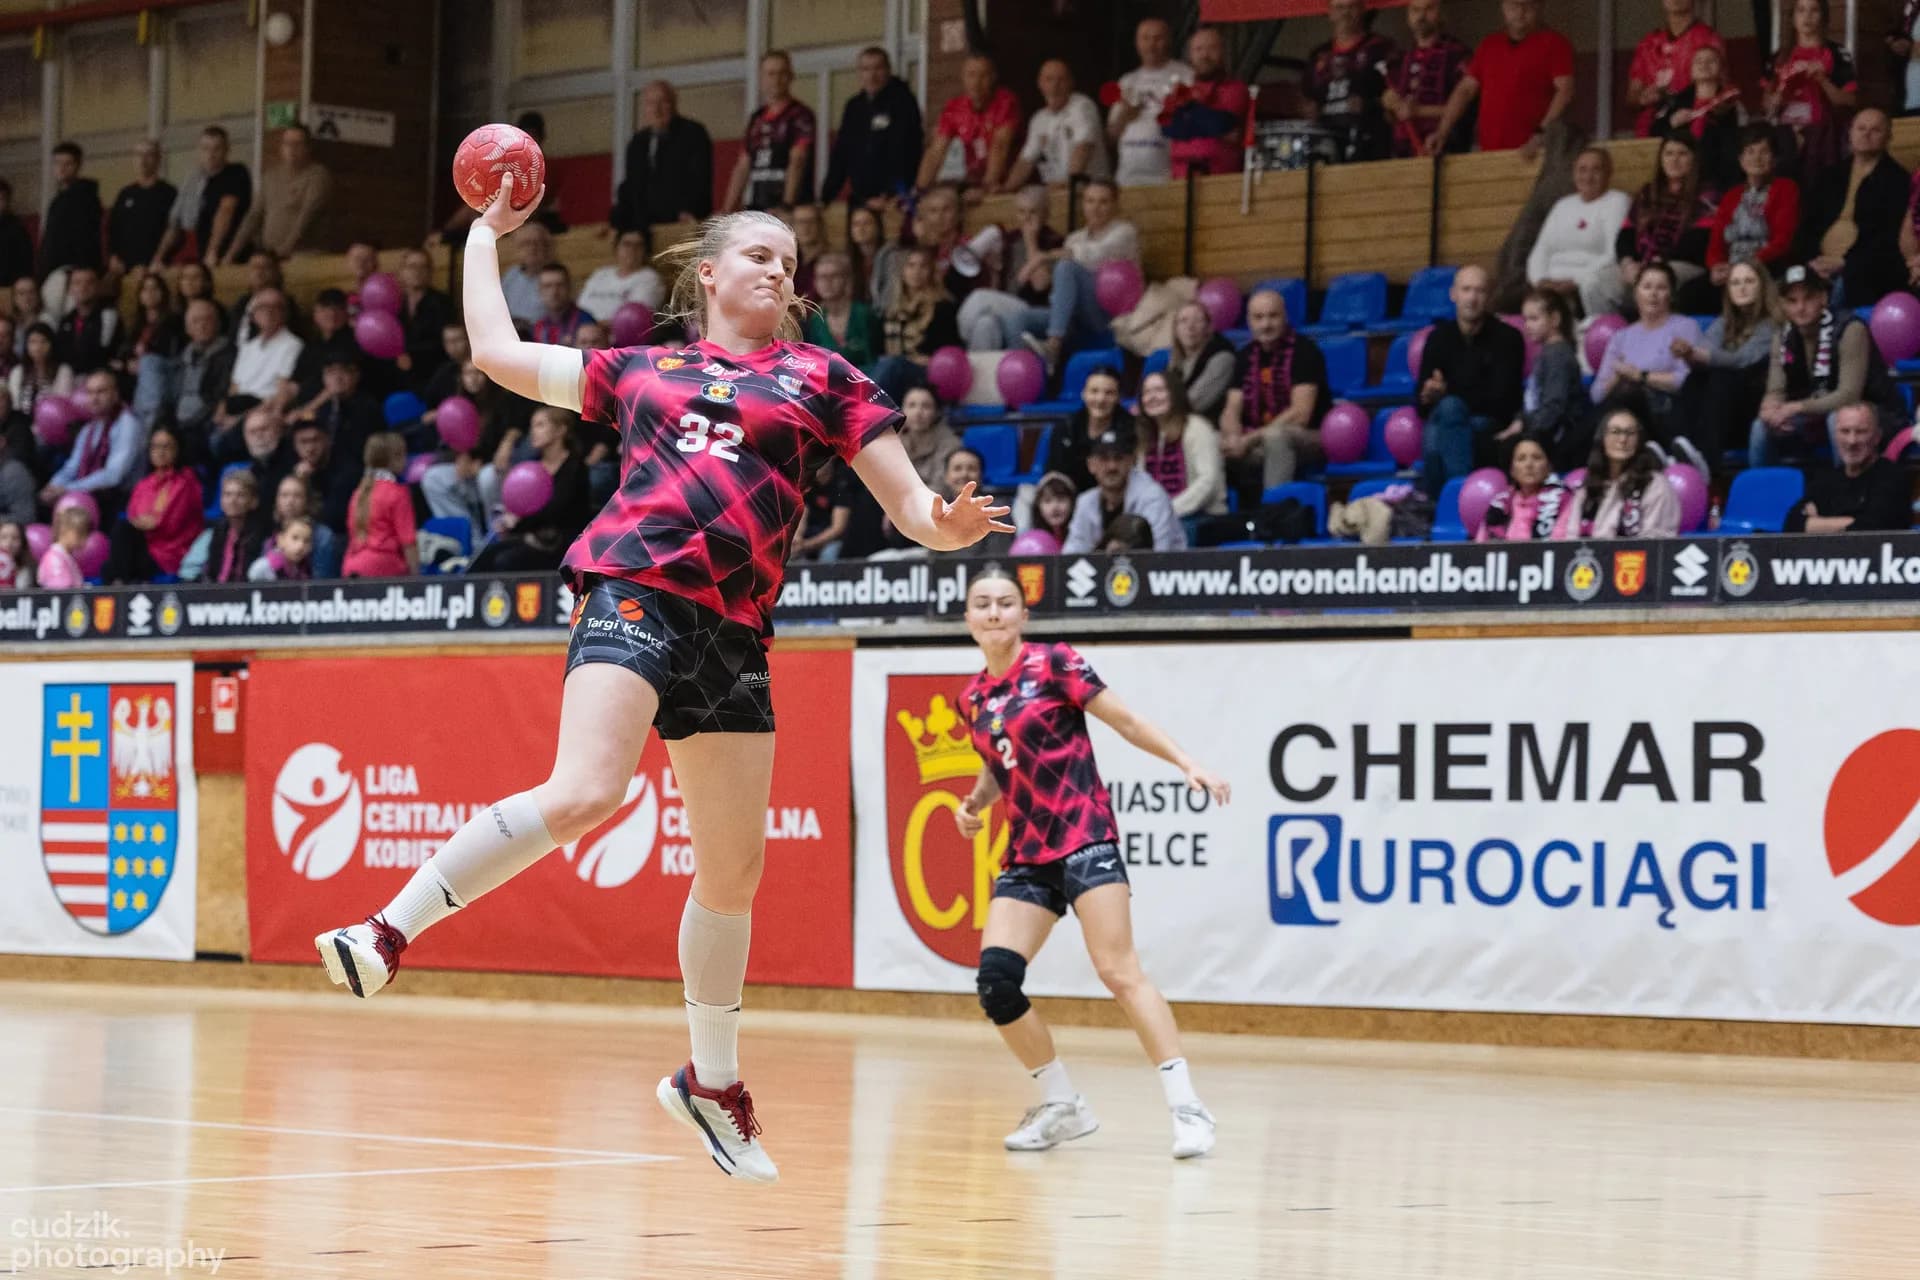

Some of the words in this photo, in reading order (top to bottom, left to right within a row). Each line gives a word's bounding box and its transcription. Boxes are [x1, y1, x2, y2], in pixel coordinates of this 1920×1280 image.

[676, 413, 745, 463] 32
[776, 563, 966, 613] ahandball.pl
[1148, 550, 1555, 604] www.koronahandball.pl
[186, 581, 475, 630] www.koronahandball.pl
[587, 617, 619, 631] Targi
[623, 622, 664, 649] Kielce
[996, 738, 1018, 770] 2
[1268, 720, 1767, 803] CHEMAR
[365, 764, 419, 796] LIGA
[1125, 832, 1208, 867] ELCE
[1268, 814, 1768, 930] RUROCIĄGI
